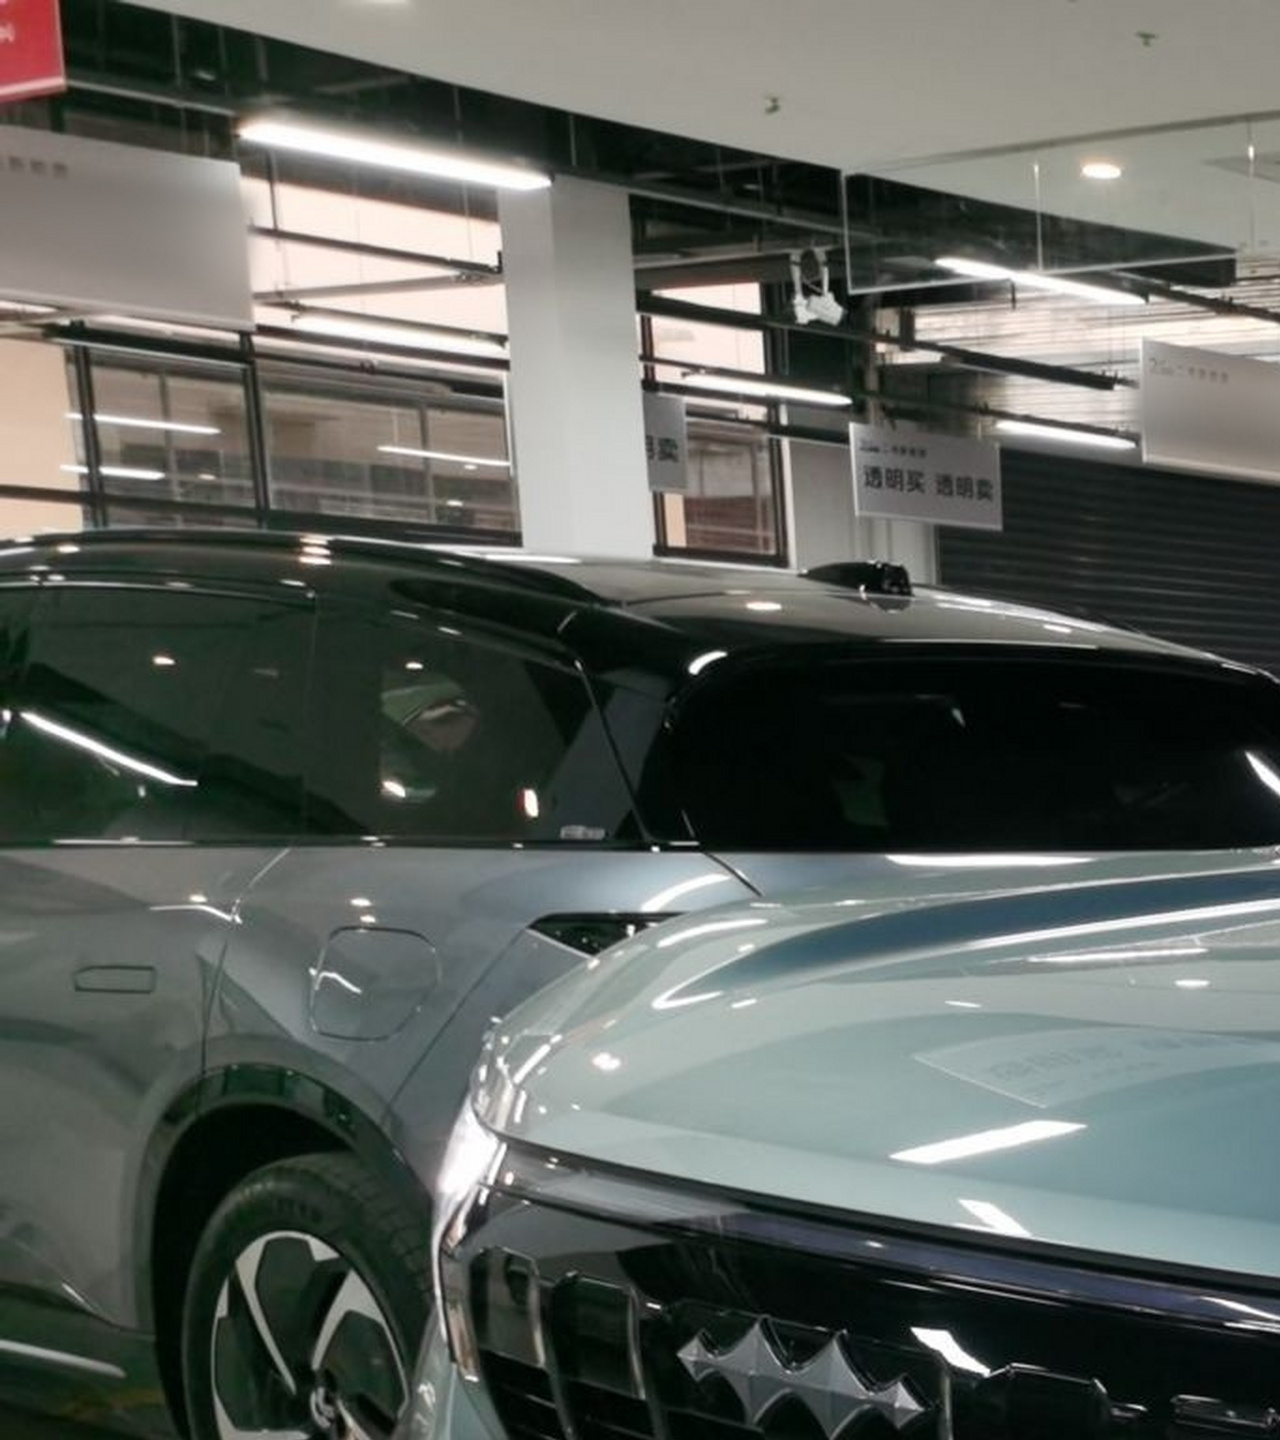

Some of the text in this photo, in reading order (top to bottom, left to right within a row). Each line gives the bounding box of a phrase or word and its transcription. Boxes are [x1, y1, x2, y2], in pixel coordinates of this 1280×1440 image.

[864, 465, 993, 501] 透明买 透明卖
